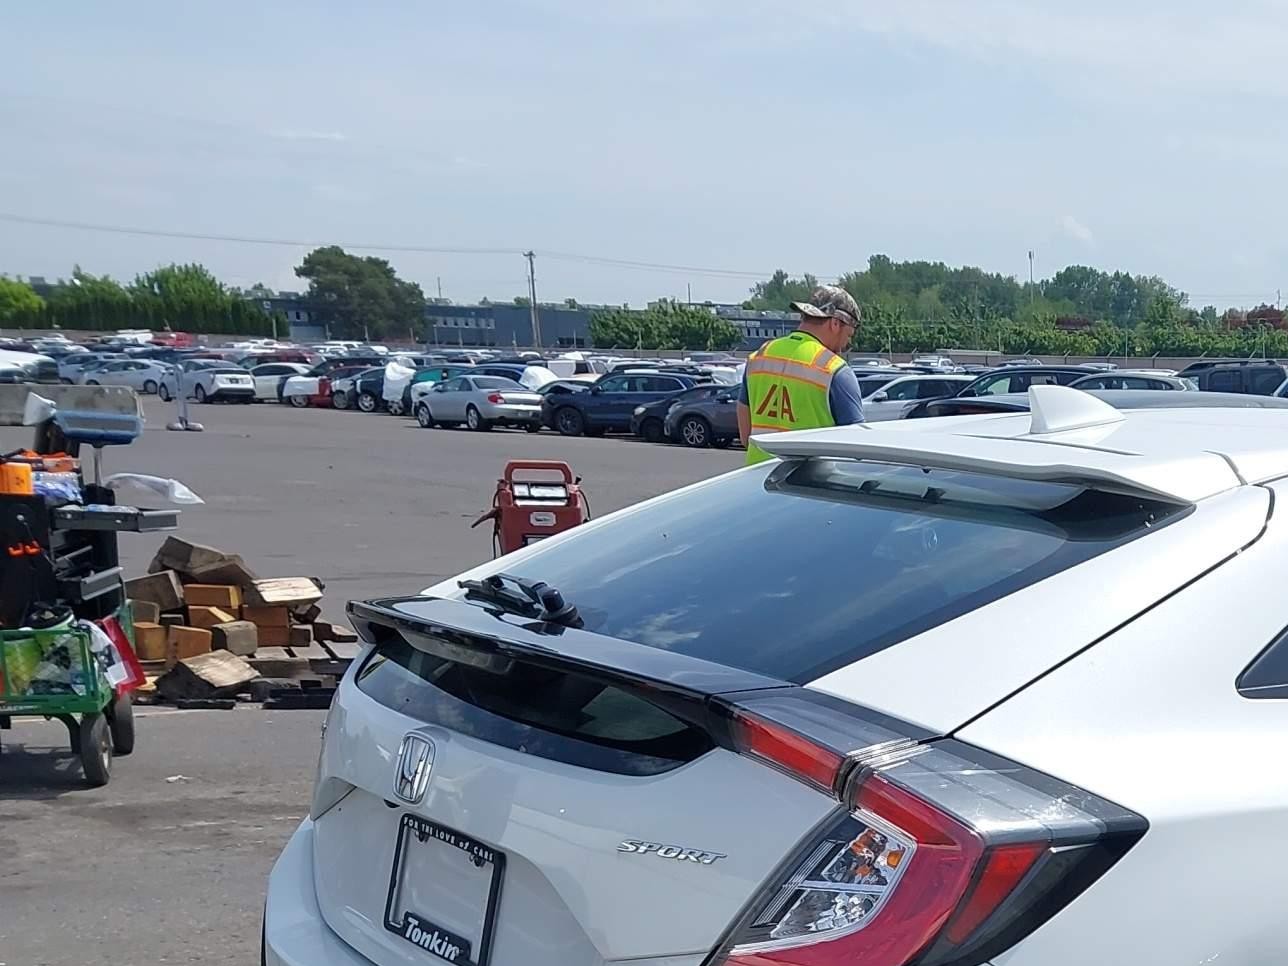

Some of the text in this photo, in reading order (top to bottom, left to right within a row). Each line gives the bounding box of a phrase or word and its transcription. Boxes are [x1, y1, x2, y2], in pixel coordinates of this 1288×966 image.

[403, 816, 494, 862] FOR THE LOVE of CARS
[616, 838, 728, 865] SPORT
[405, 916, 460, 961] Tonkin
